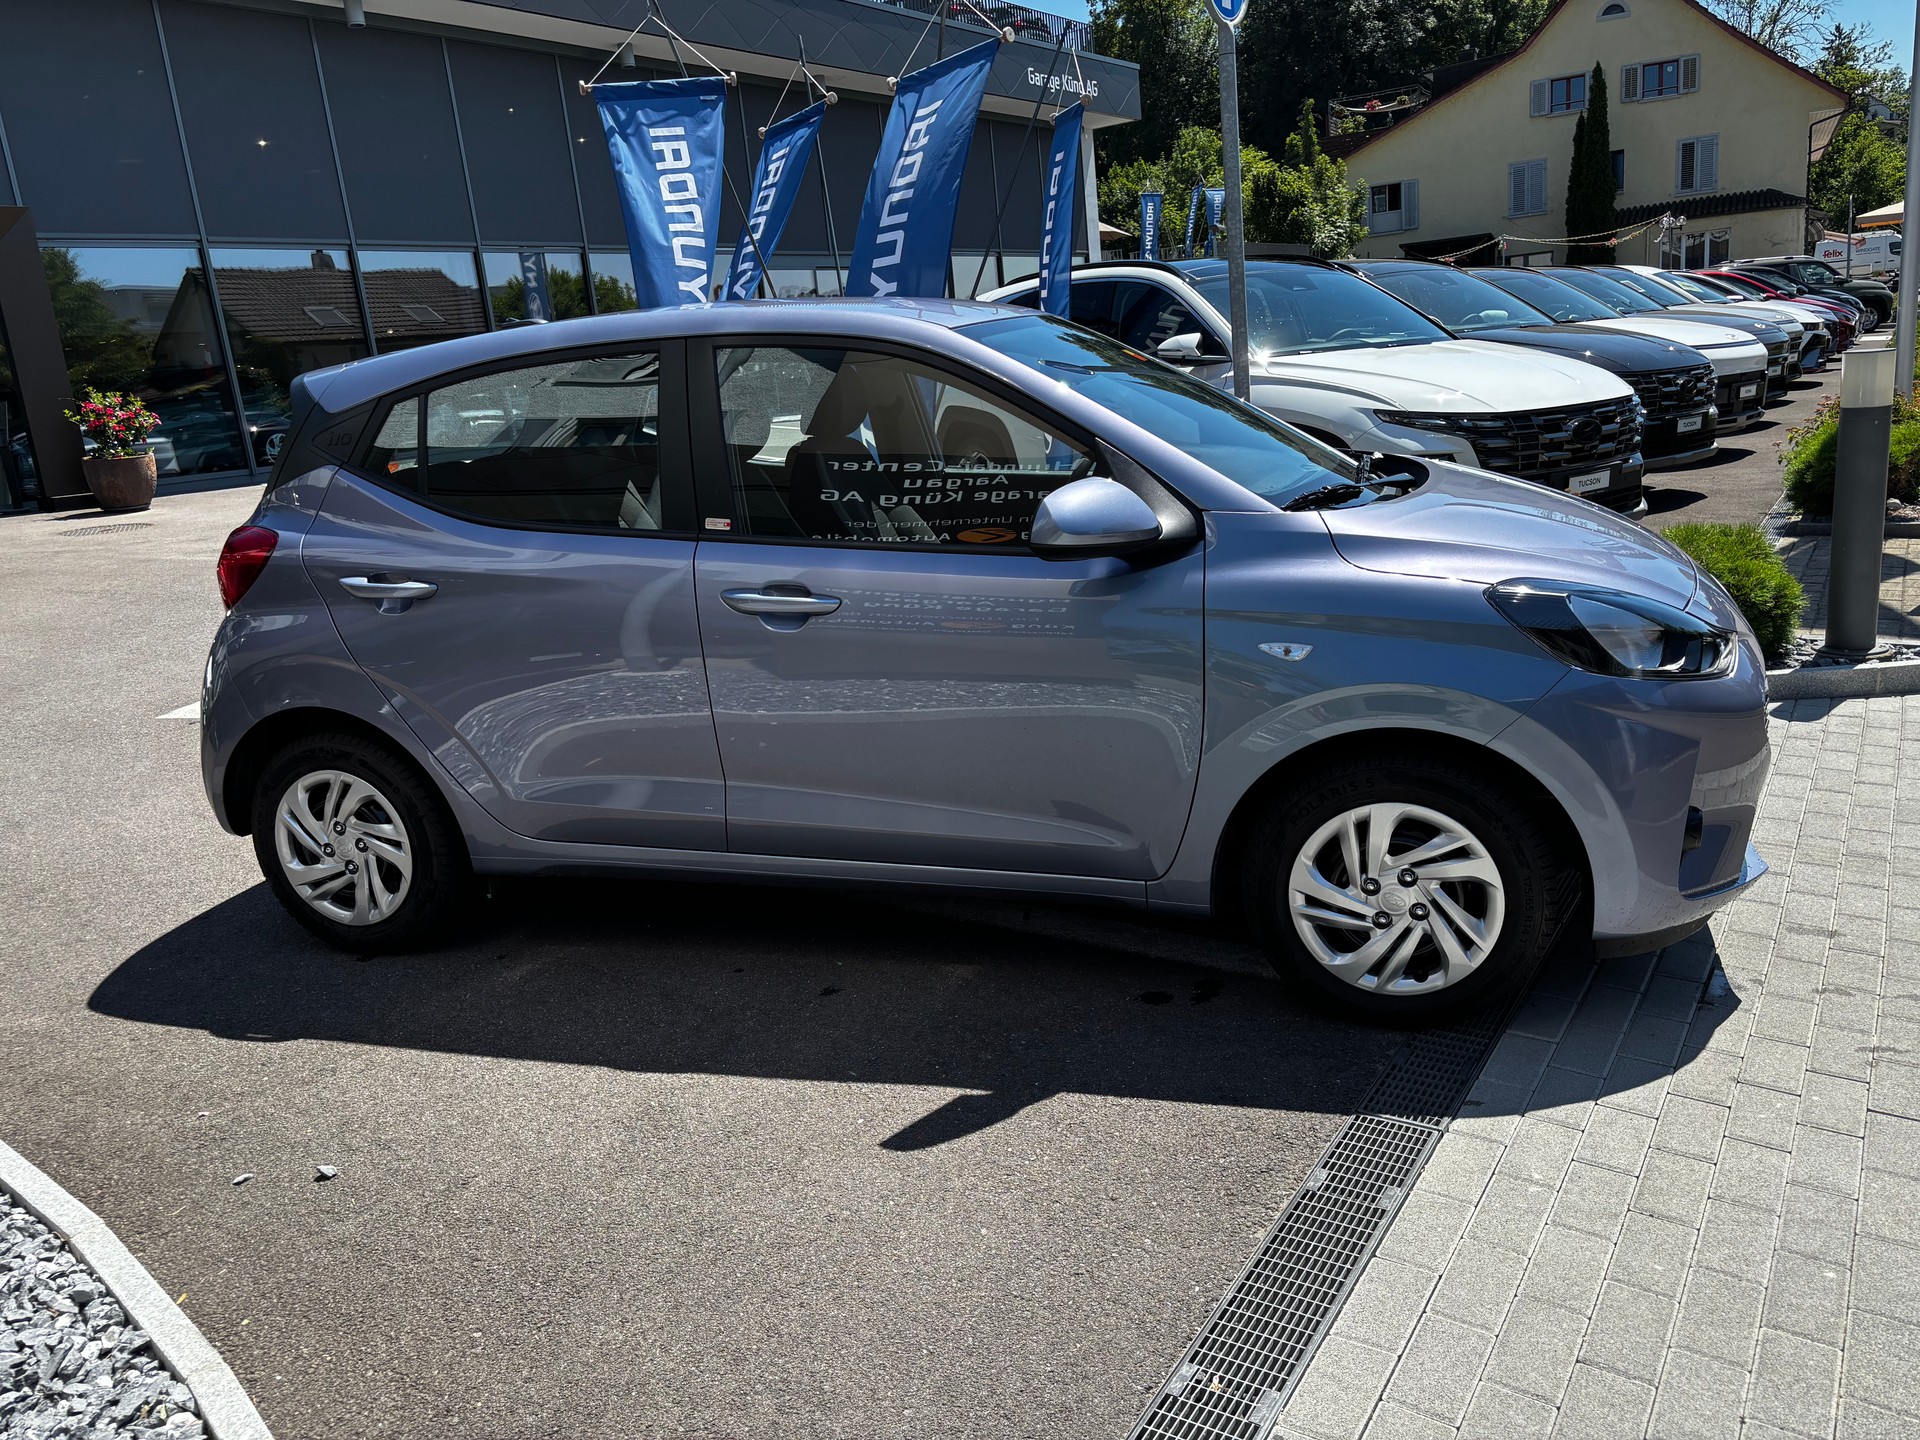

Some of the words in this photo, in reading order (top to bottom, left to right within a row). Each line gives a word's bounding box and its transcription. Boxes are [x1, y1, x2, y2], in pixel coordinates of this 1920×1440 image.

[1086, 79, 1099, 97] AG
[1145, 202, 1154, 249] HYUNDAI
[1578, 477, 1601, 488] TUCSON
[1289, 780, 1359, 826] POLARIS
[1365, 777, 1375, 788] 5
[1522, 875, 1534, 912] 175/65
